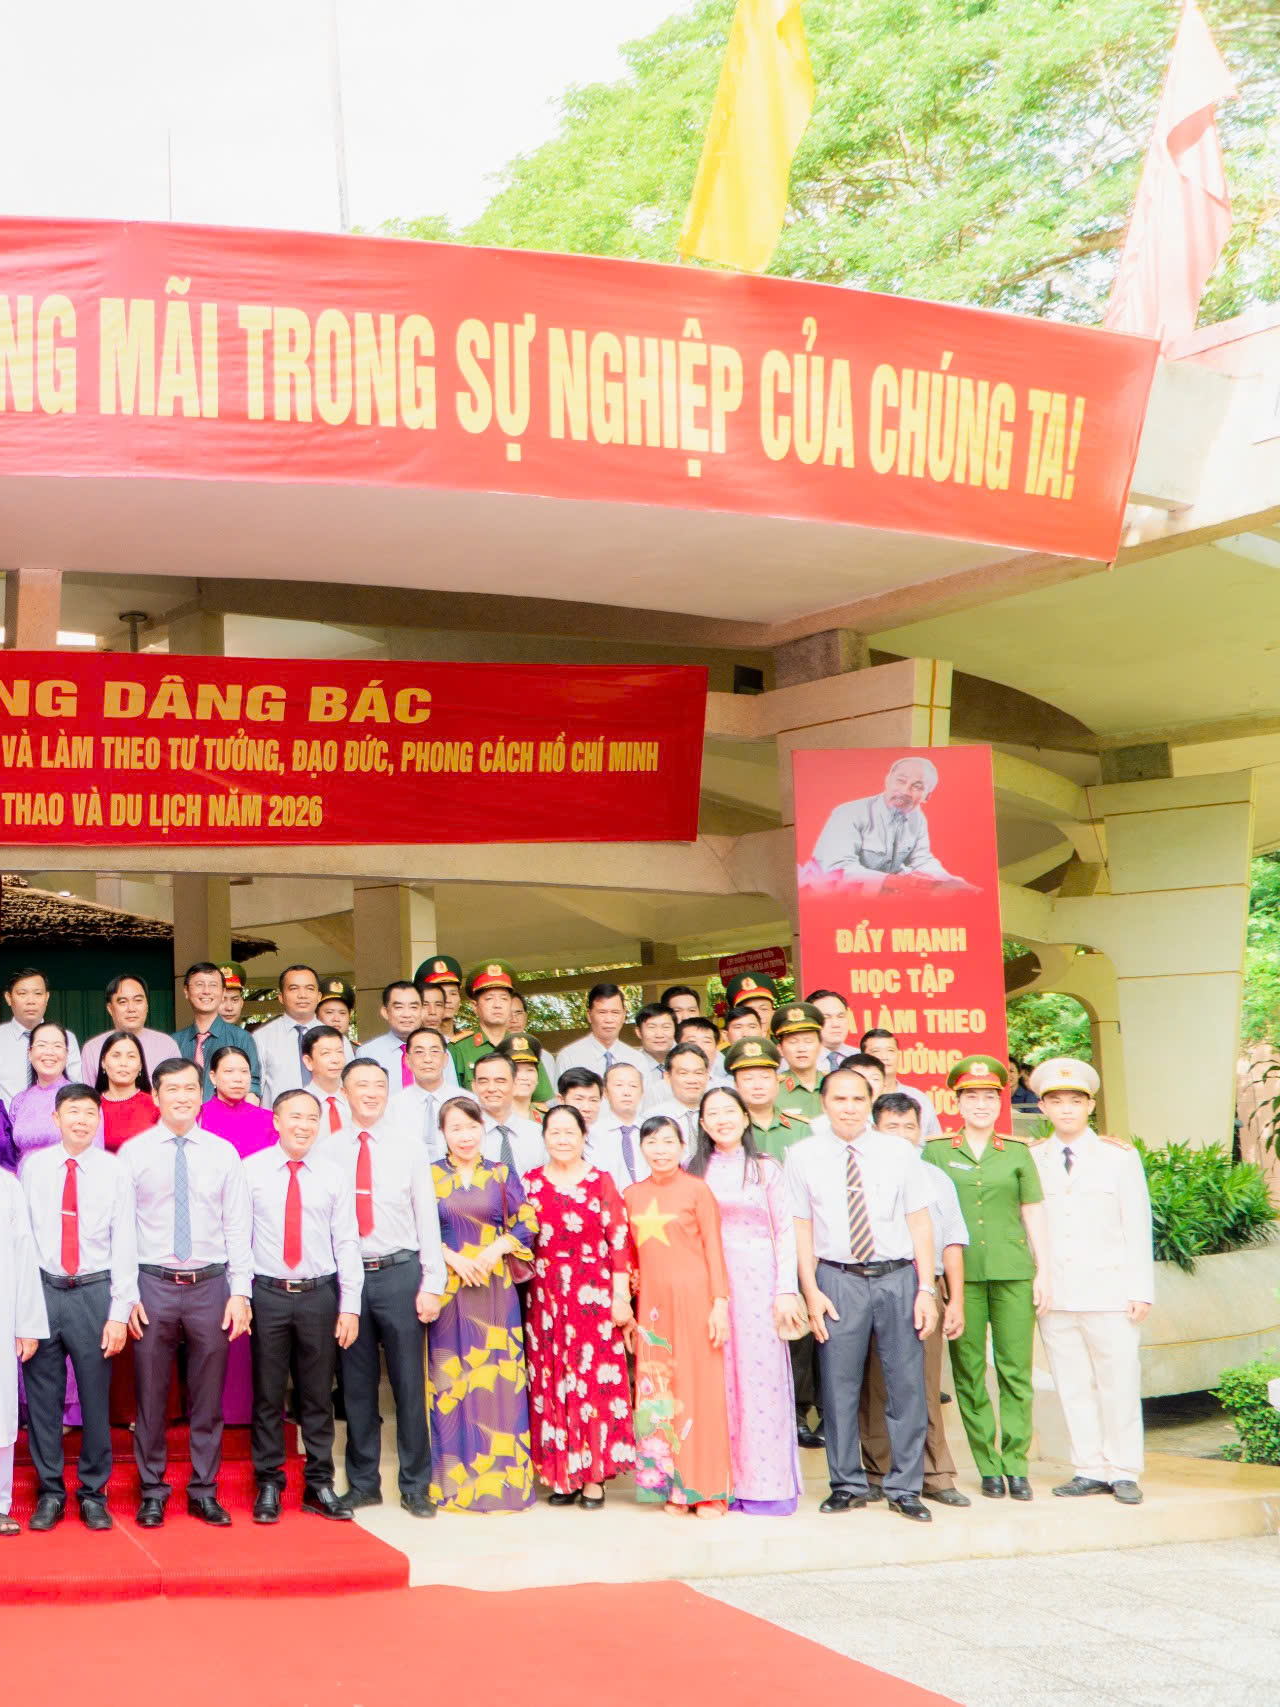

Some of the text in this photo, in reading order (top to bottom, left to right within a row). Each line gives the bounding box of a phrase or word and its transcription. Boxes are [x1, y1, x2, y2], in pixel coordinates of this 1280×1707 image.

[99, 277, 219, 418] MÃI
[238, 305, 436, 430] TRONG
[456, 312, 535, 462] SỰ
[549, 318, 743, 477] NGHIỆP
[760, 317, 854, 469] CỦA
[868, 350, 1015, 494] CHÚNG
[1025, 388, 1085, 500] TA!
[104, 675, 286, 722] DÂNG
[308, 680, 432, 723] BÁC
[2, 729, 34, 768] VÀ
[41, 729, 93, 769] LÀM
[101, 737, 160, 770] THEO
[168, 735, 200, 770] TƯ
[204, 728, 285, 775] TƯỞNG,
[292, 741, 337, 778] ĐẠO
[344, 734, 394, 776] ĐỨC,
[401, 740, 473, 773] PHONG
[479, 736, 533, 772] CÁCH
[538, 731, 567, 772] HỒ
[571, 736, 605, 772] CHÍ
[608, 741, 659, 772] MINH
[2, 792, 64, 826] THAO
[73, 787, 103, 826] VÀ
[111, 793, 143, 827] DU
[150, 794, 201, 834] LỊCH
[209, 787, 262, 827] NĂM
[268, 795, 323, 827] 2026
[836, 920, 966, 957] ĐẨY MẠNH
[850, 963, 954, 998] HỌC TẬP
[923, 1008, 987, 1033] THEO
